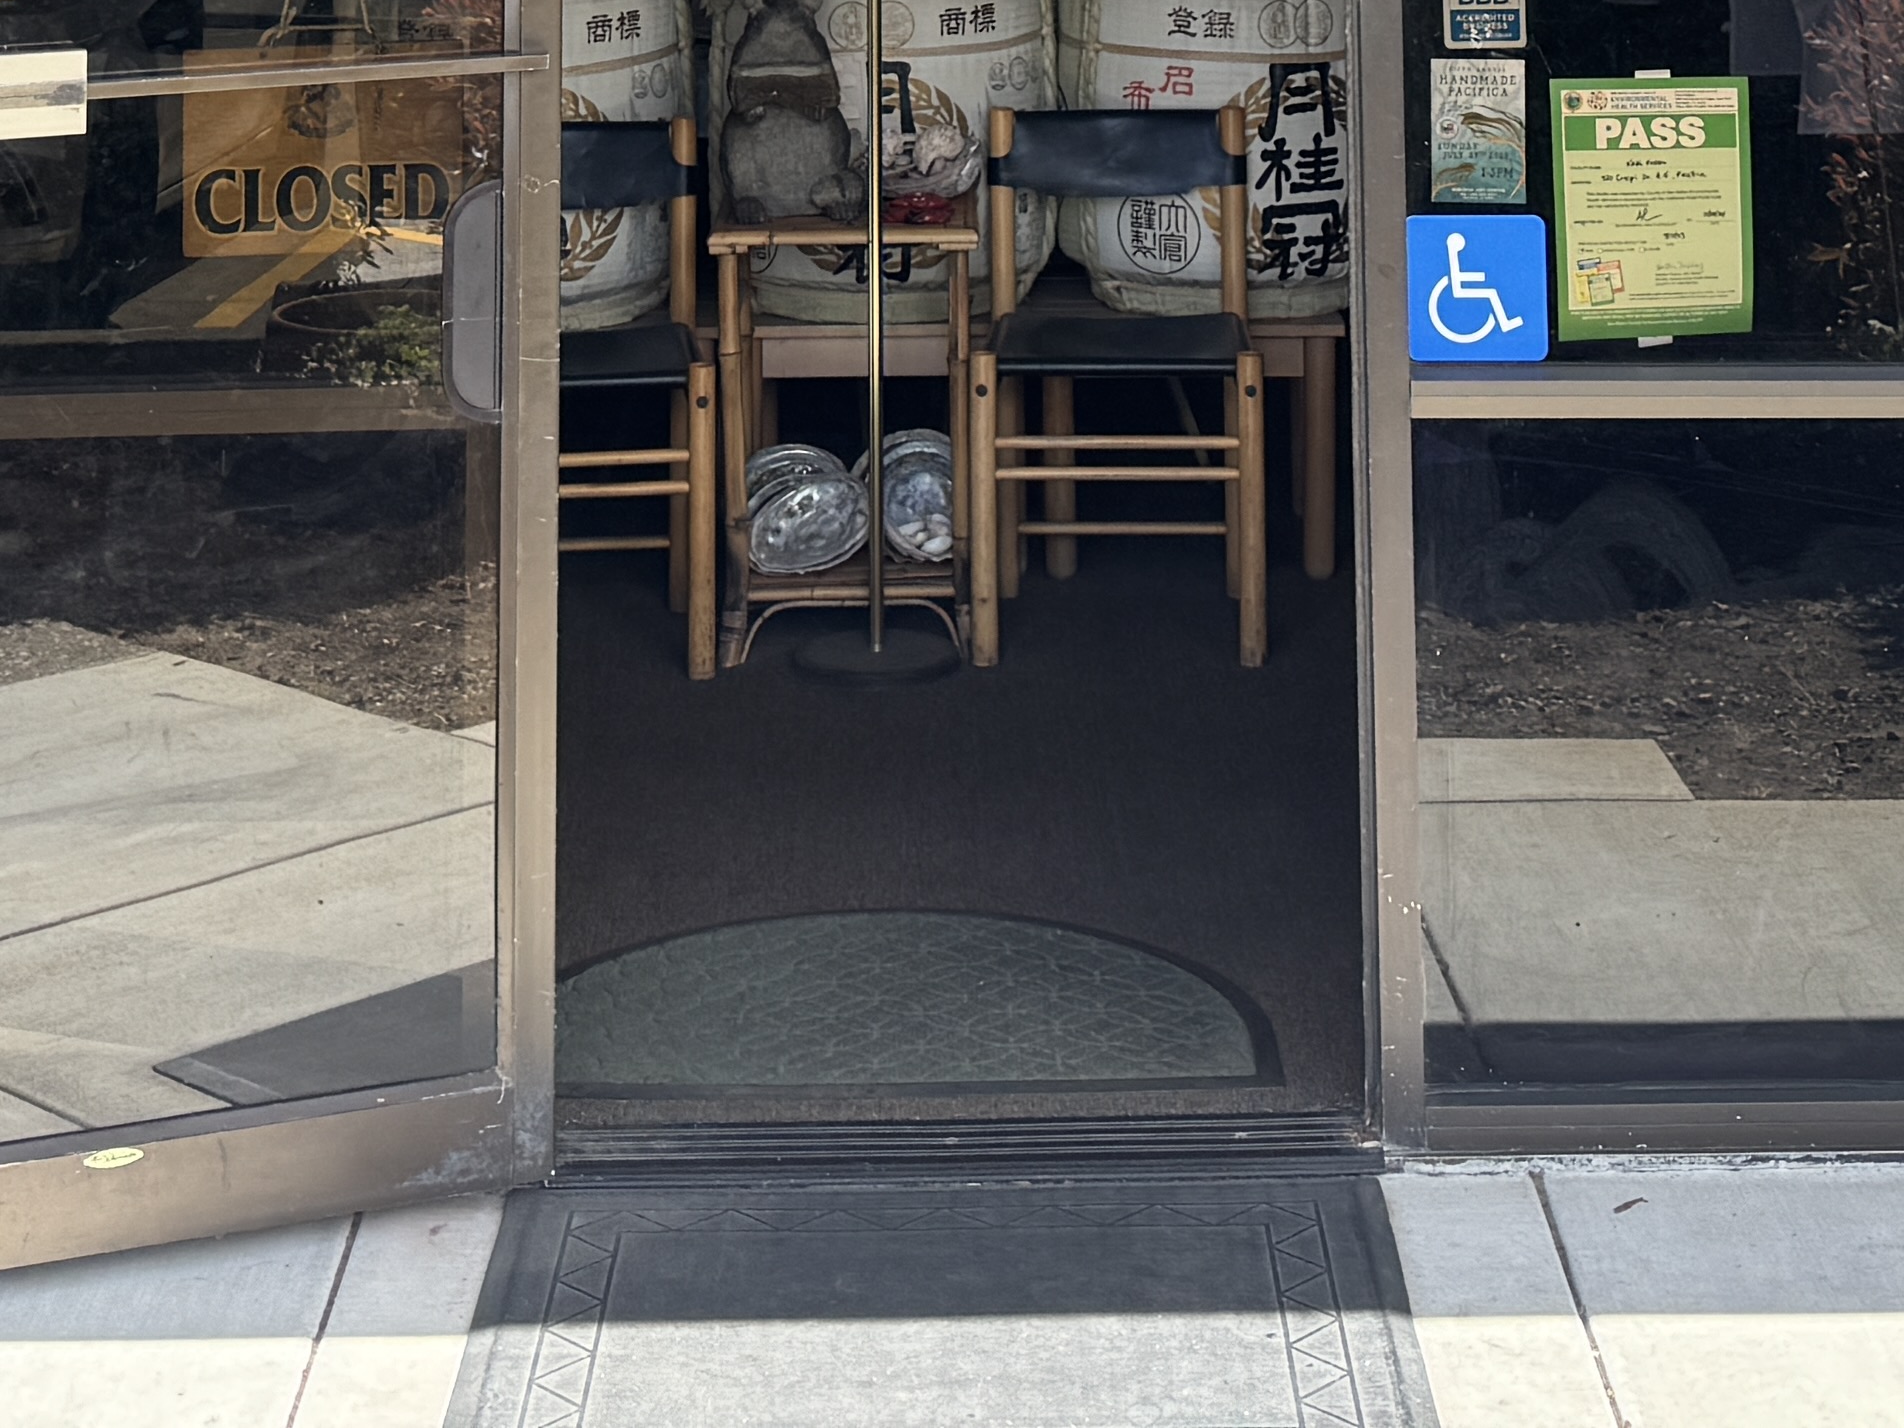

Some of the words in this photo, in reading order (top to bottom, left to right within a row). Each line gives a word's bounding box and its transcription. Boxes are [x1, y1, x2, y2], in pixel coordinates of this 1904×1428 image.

[586, 8, 642, 44] 商標
[937, 1, 998, 37] 商標
[1439, 74, 1517, 86] HANDMADE
[1448, 86, 1508, 98] PACIFICA
[1596, 115, 1706, 150] PASS
[1255, 61, 1345, 282] 月桂冠
[193, 161, 452, 236] CLOSED
